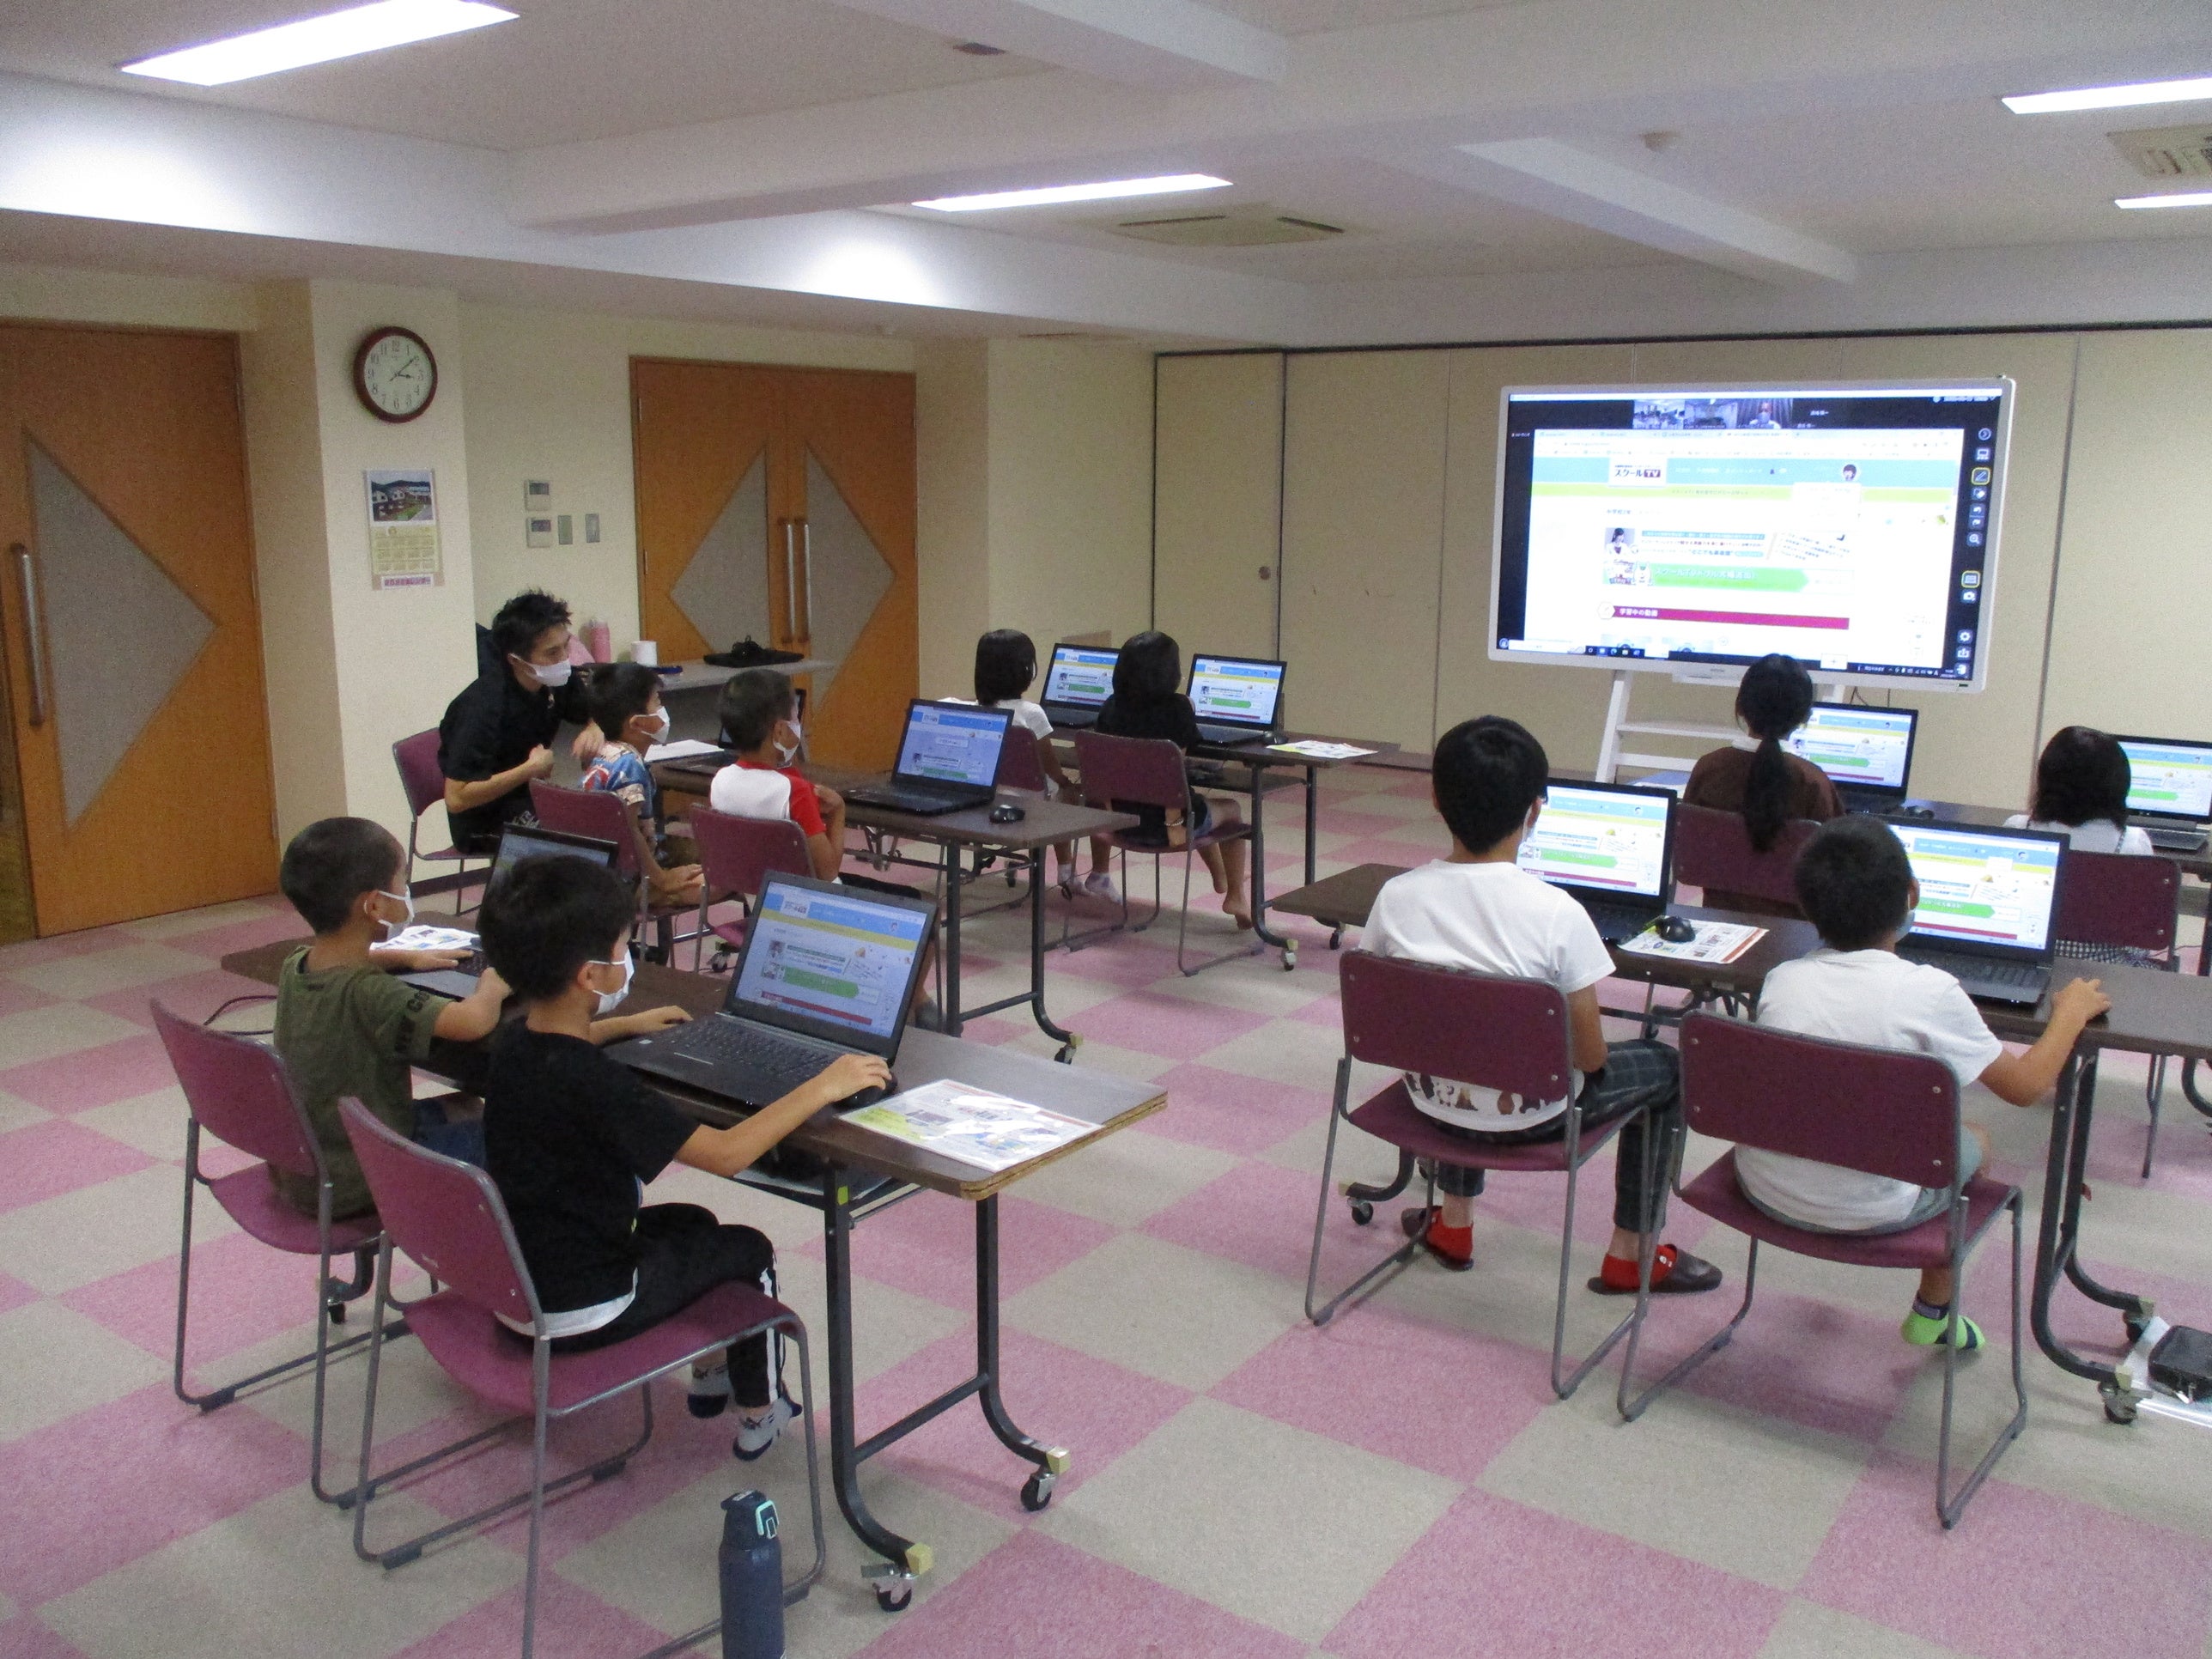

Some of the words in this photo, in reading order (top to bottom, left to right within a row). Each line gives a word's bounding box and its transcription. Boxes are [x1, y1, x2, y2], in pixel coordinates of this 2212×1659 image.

[380, 343, 387, 356] 11
[392, 339, 400, 352] 12
[368, 368, 374, 379] 9
[371, 382, 379, 394] 8
[413, 384, 420, 395] 4
[393, 398, 400, 410] 6
[1614, 469, 1662, 478] スクールTV
[1620, 607, 1658, 617] 学習中の動画
